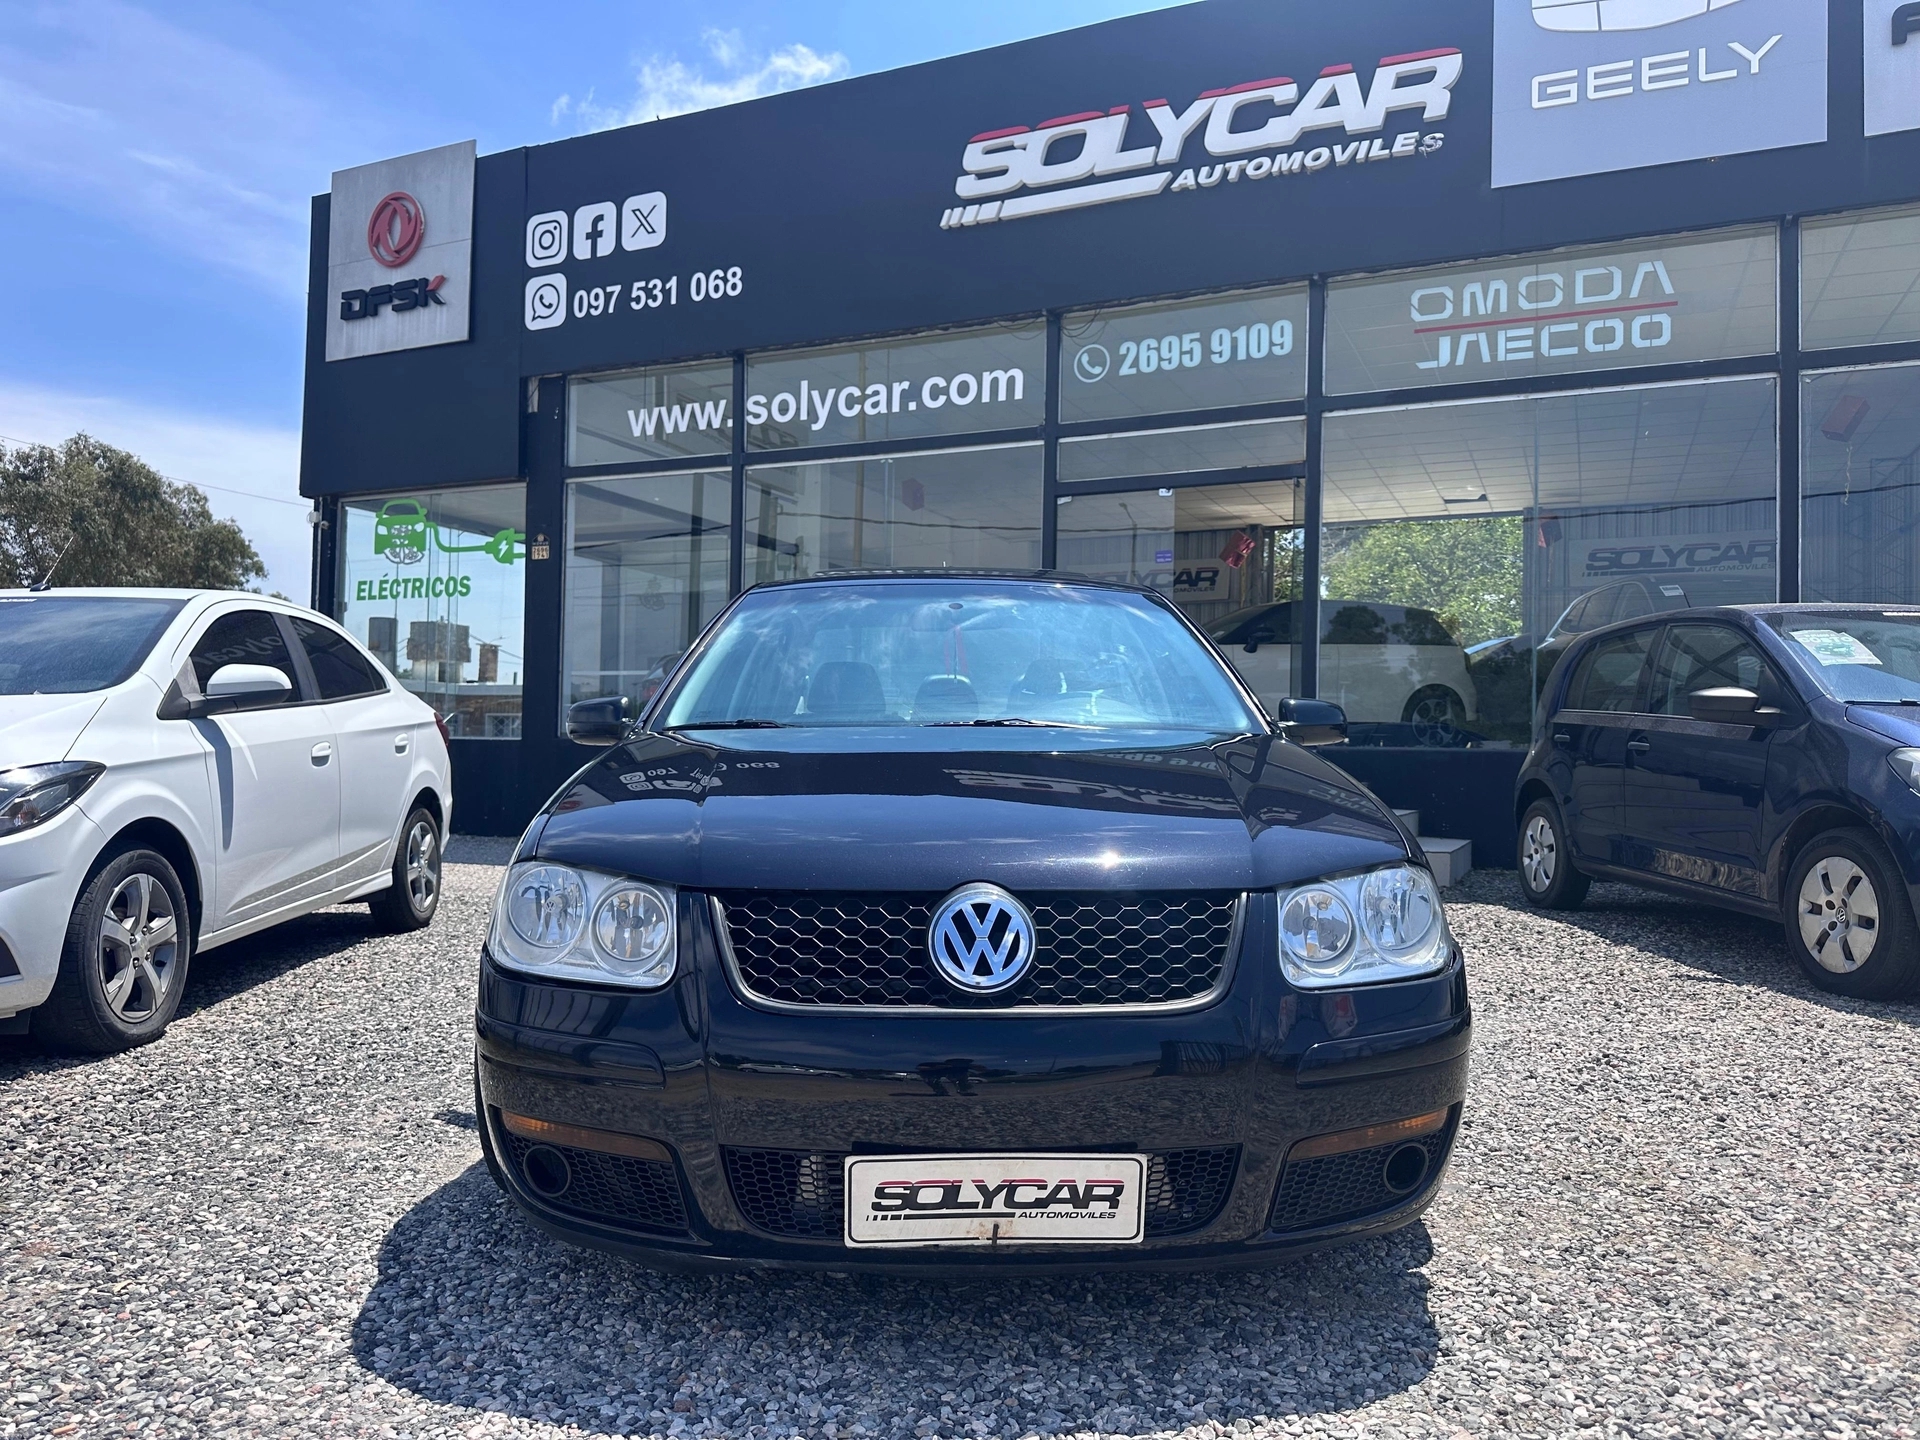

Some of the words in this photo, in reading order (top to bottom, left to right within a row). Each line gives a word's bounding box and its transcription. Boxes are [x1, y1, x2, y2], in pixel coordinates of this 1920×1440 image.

[1531, 33, 1783, 110] GEELY
[955, 47, 1463, 199] SOLYCAR
[1170, 131, 1445, 192] AUTOMOVILES
[341, 275, 447, 322] DFSK
[573, 285, 622, 319] 097
[630, 275, 679, 311] 531
[690, 266, 743, 302] 068
[1410, 260, 1675, 323] OMODA
[1118, 333, 1202, 377] 2695
[1211, 318, 1294, 364] 9109
[1415, 312, 1672, 370] JAECOO
[356, 573, 471, 601] ELÉCTRICOS
[871, 1178, 1125, 1212] SOLYCAR
[1017, 1211, 1117, 1219] AUTOMOVILES
